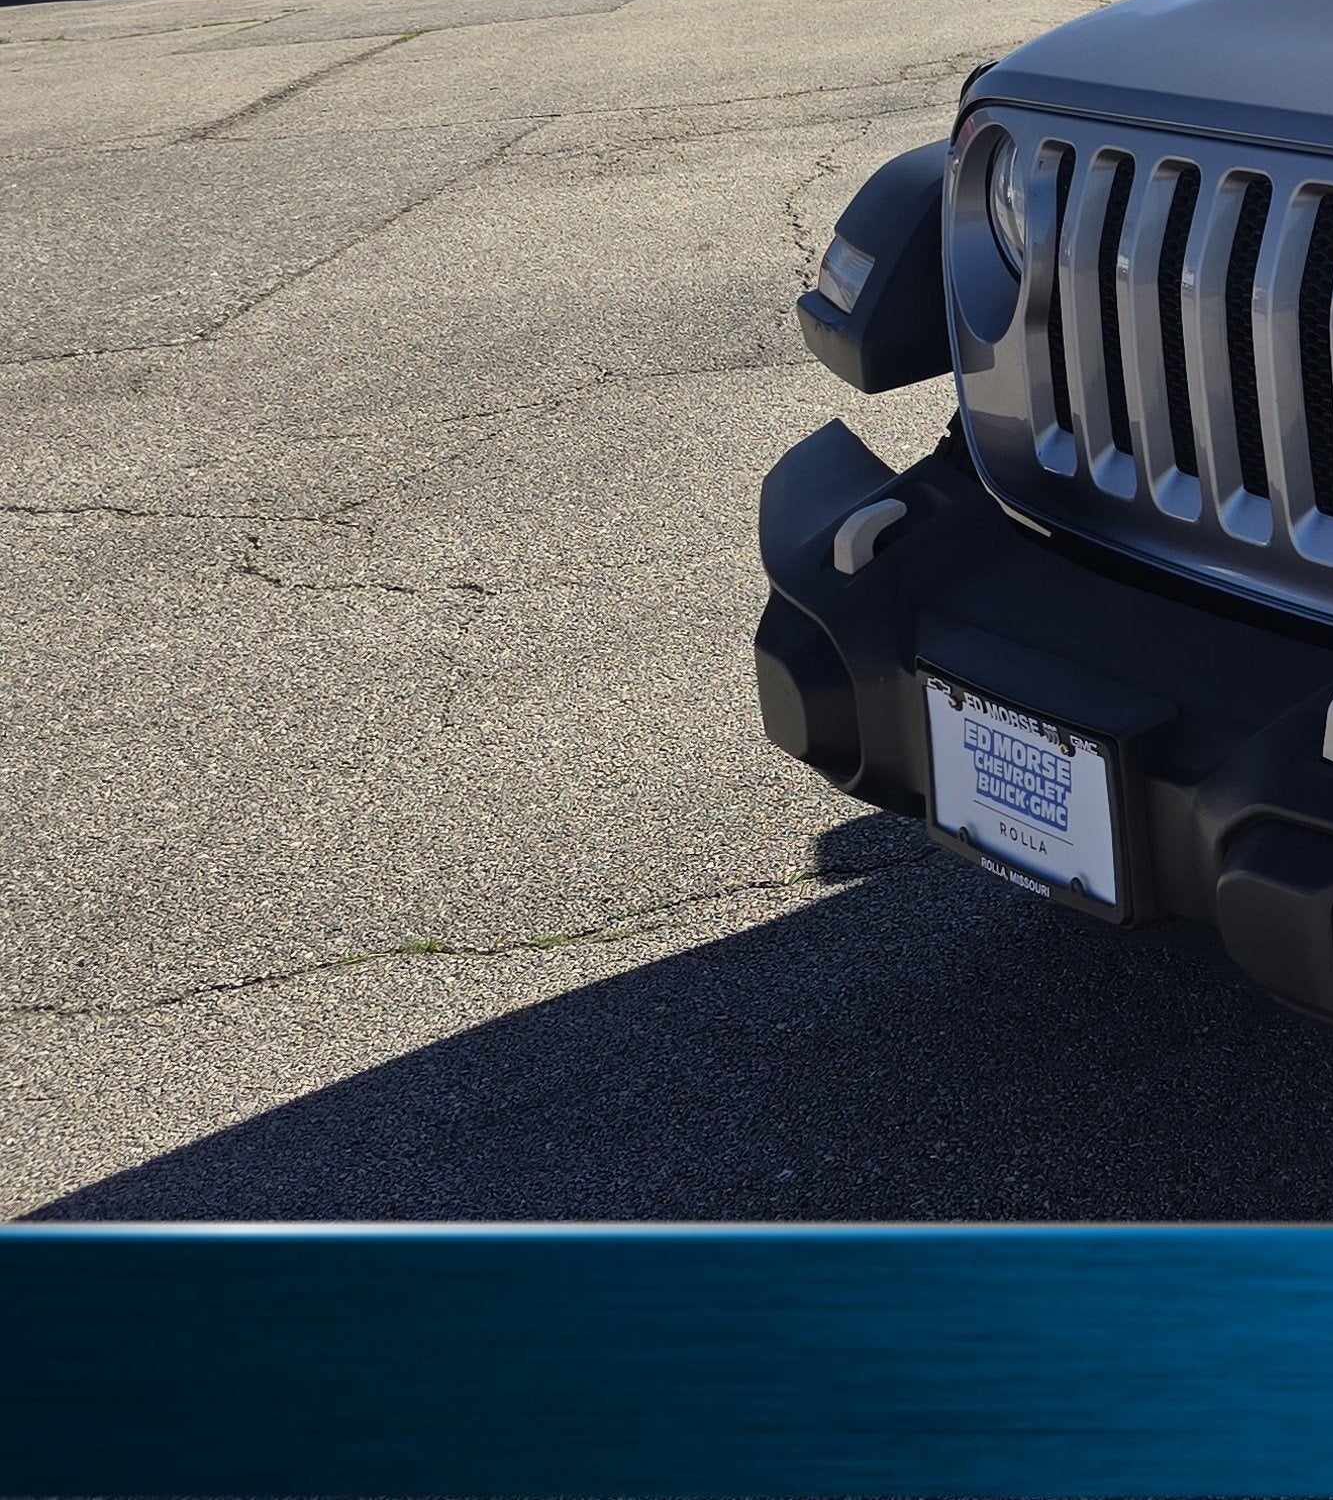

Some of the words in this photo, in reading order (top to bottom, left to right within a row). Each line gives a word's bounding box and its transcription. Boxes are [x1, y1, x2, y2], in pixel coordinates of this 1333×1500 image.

[964, 692, 983, 712] ED
[966, 721, 991, 752] ED
[994, 733, 1071, 786] MORSE
[975, 750, 1065, 804] CHEVROLET
[999, 822, 1047, 855] ROLLA
[1009, 870, 1051, 897] MISSOURI
